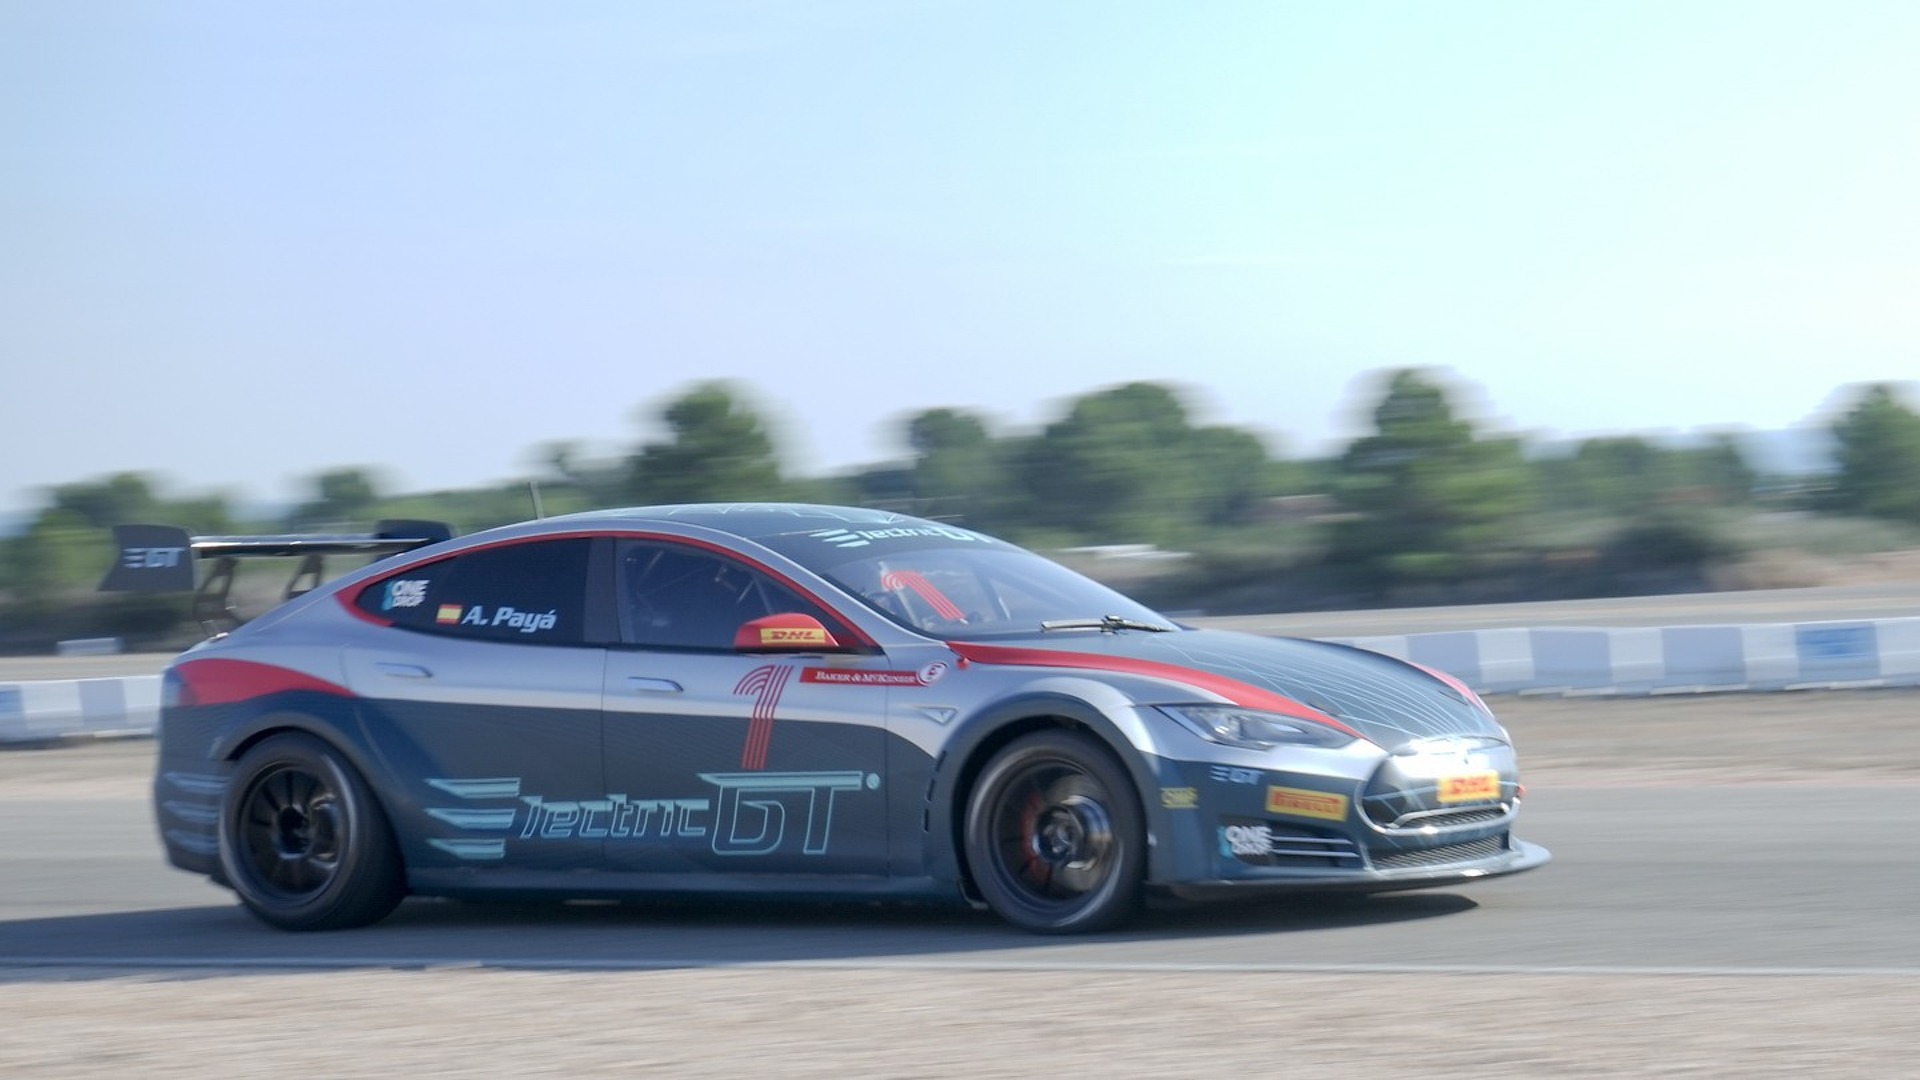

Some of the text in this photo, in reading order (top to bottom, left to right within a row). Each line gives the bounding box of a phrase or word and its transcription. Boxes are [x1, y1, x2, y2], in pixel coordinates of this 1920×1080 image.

[391, 580, 430, 596] ONE
[461, 605, 558, 633] A. Payá
[770, 631, 816, 640] DHL
